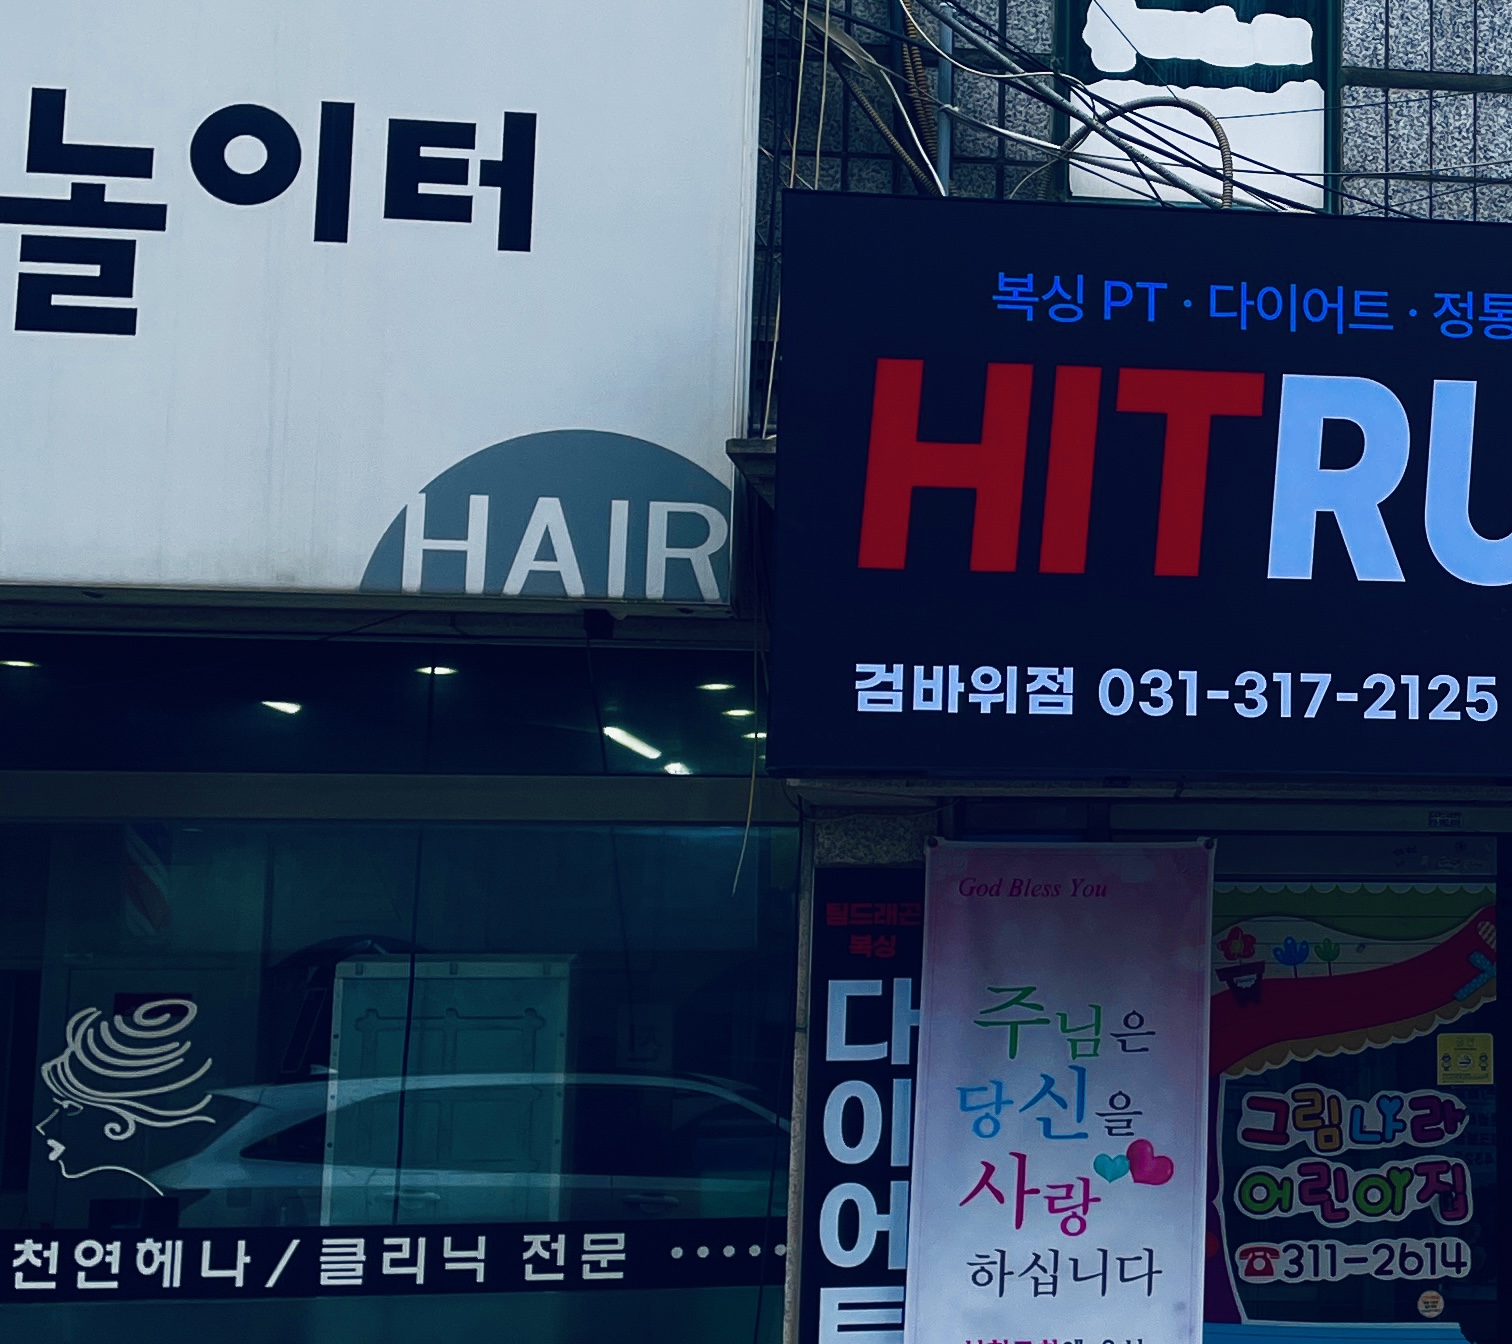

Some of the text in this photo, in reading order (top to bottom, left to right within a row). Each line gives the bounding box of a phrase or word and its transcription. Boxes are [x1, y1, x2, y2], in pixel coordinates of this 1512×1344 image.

[0, 86, 538, 336] 놀이터
[992, 271, 1085, 323] 복싱
[1104, 279, 1168, 323] PT
[1208, 281, 1394, 334] 다이어트
[404, 492, 730, 601] HAIR
[854, 662, 1075, 715] 검바위점
[1097, 667, 1499, 722] 031-317-2125
[957, 877, 1108, 899] God Bless You
[848, 933, 897, 959] 복싱
[974, 985, 1157, 1061] 주님은
[956, 1064, 1144, 1141] 당신을
[959, 1150, 1103, 1238] 사랑
[521, 1232, 627, 1281] 전문
[966, 1247, 1163, 1299] 하십니다
[1282, 1241, 1469, 1278] 311-2614
